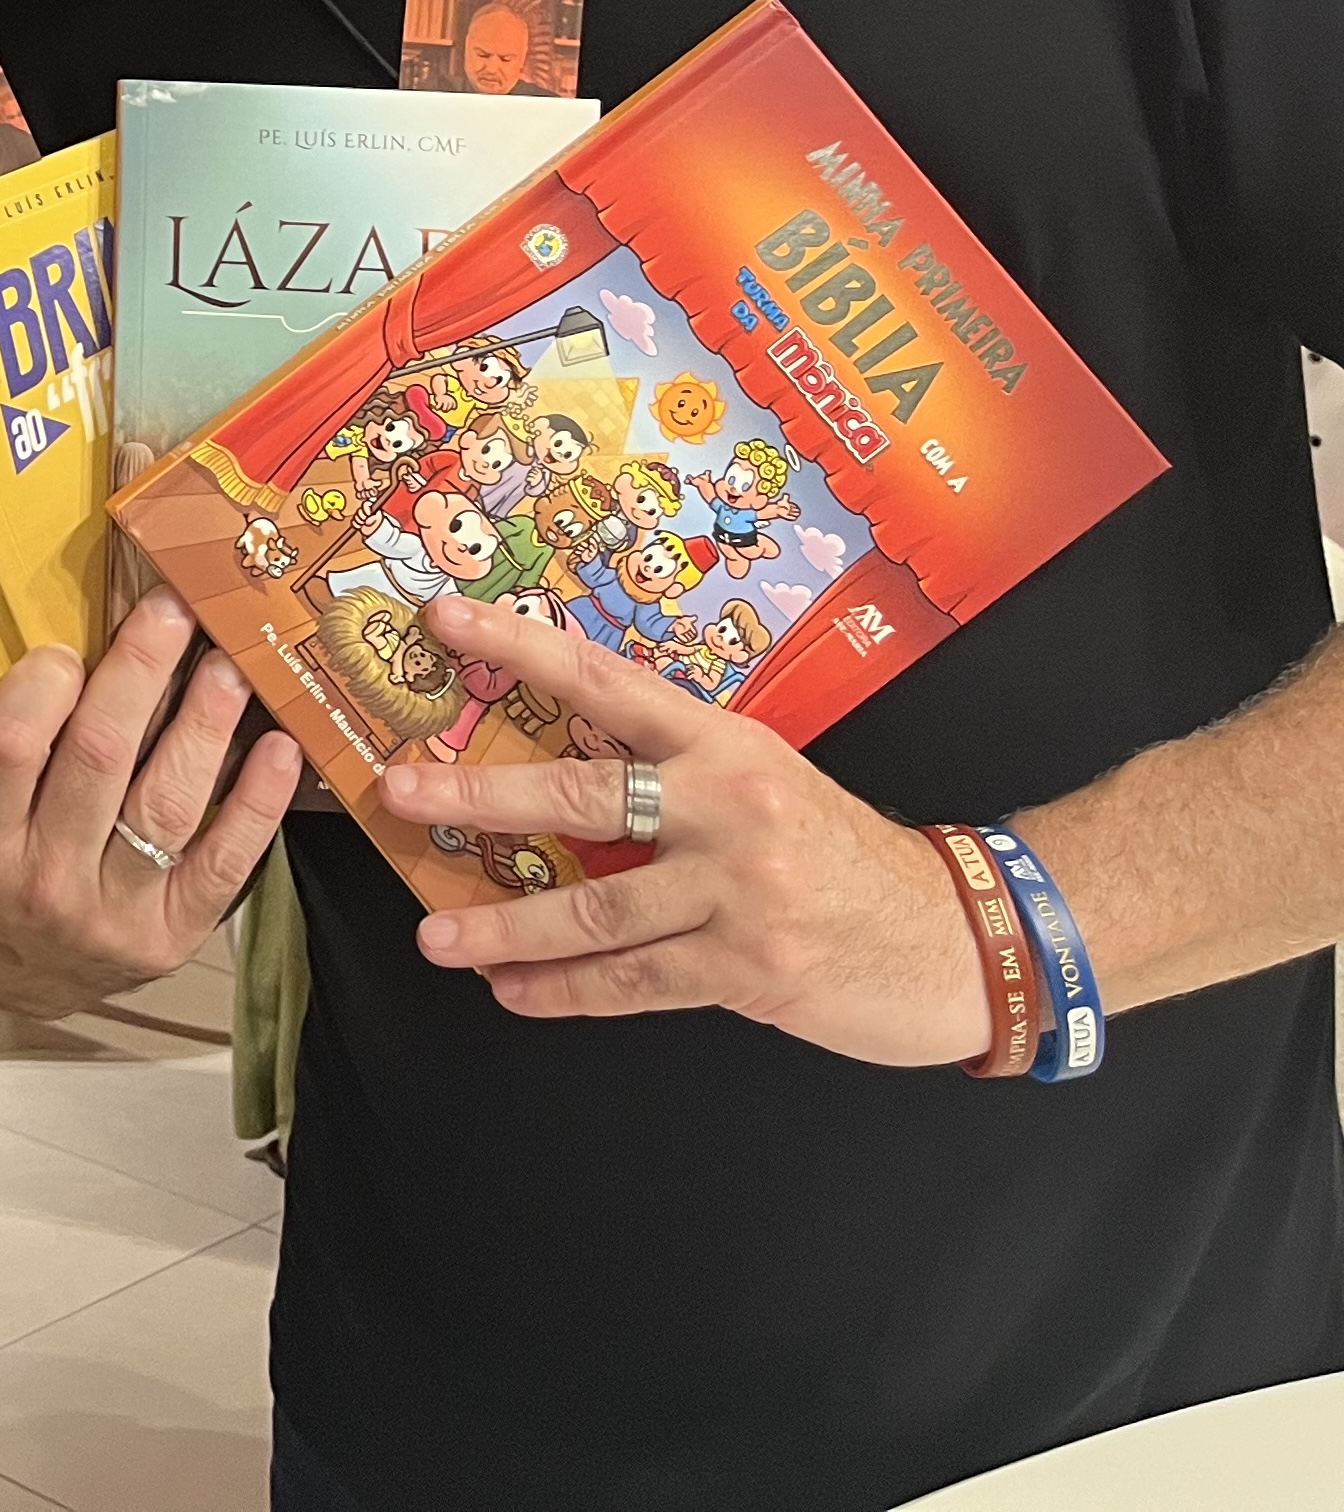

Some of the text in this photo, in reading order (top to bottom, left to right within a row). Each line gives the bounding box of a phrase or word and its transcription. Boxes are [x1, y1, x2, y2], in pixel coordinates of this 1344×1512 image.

[259, 129, 288, 146] PE.
[295, 128, 336, 150] LUÍS
[418, 135, 467, 156] CMF
[805, 140, 1029, 395] MINHA PRIMEIRA
[730, 300, 759, 331] DA
[736, 266, 790, 332] TURMA
[754, 208, 944, 424] BÍBLIA
[11, 407, 47, 461] ao
[919, 438, 969, 495] COM A
[260, 622, 278, 646] Pe.
[277, 643, 302, 673] Luís
[300, 671, 326, 704] Erlin
[330, 708, 375, 763] Maurício
[372, 763, 387, 776] d
[953, 838, 980, 868] TUA
[972, 870, 990, 884] A
[985, 898, 1010, 936] MIM
[999, 947, 1021, 980] EM
[1030, 891, 1083, 999] VONTADE
